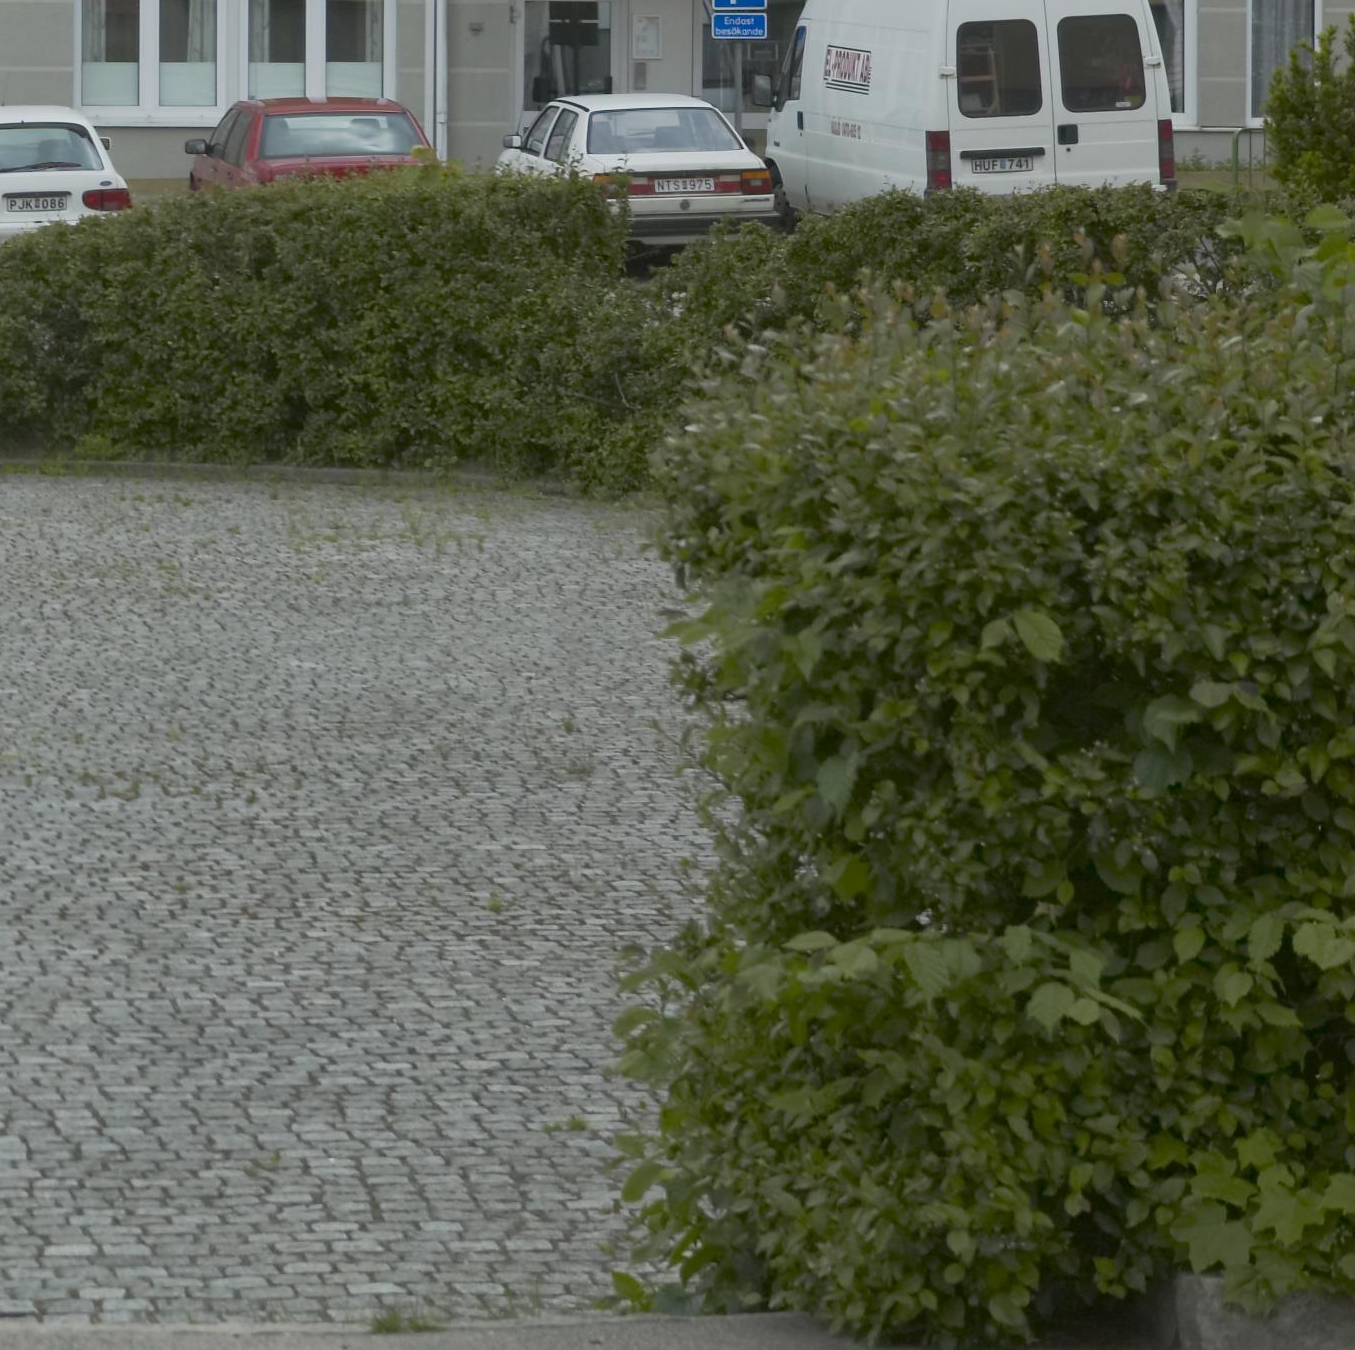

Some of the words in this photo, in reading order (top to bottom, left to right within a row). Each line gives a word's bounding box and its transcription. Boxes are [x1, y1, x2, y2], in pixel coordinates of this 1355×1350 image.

[724, 16, 755, 25] Endast
[715, 26, 764, 36] besökande
[974, 159, 998, 171] HUF
[1008, 158, 1029, 169] 741
[657, 179, 680, 191] NTS
[690, 179, 712, 190] 975
[9, 199, 33, 210] PJK
[42, 198, 65, 209] 086
